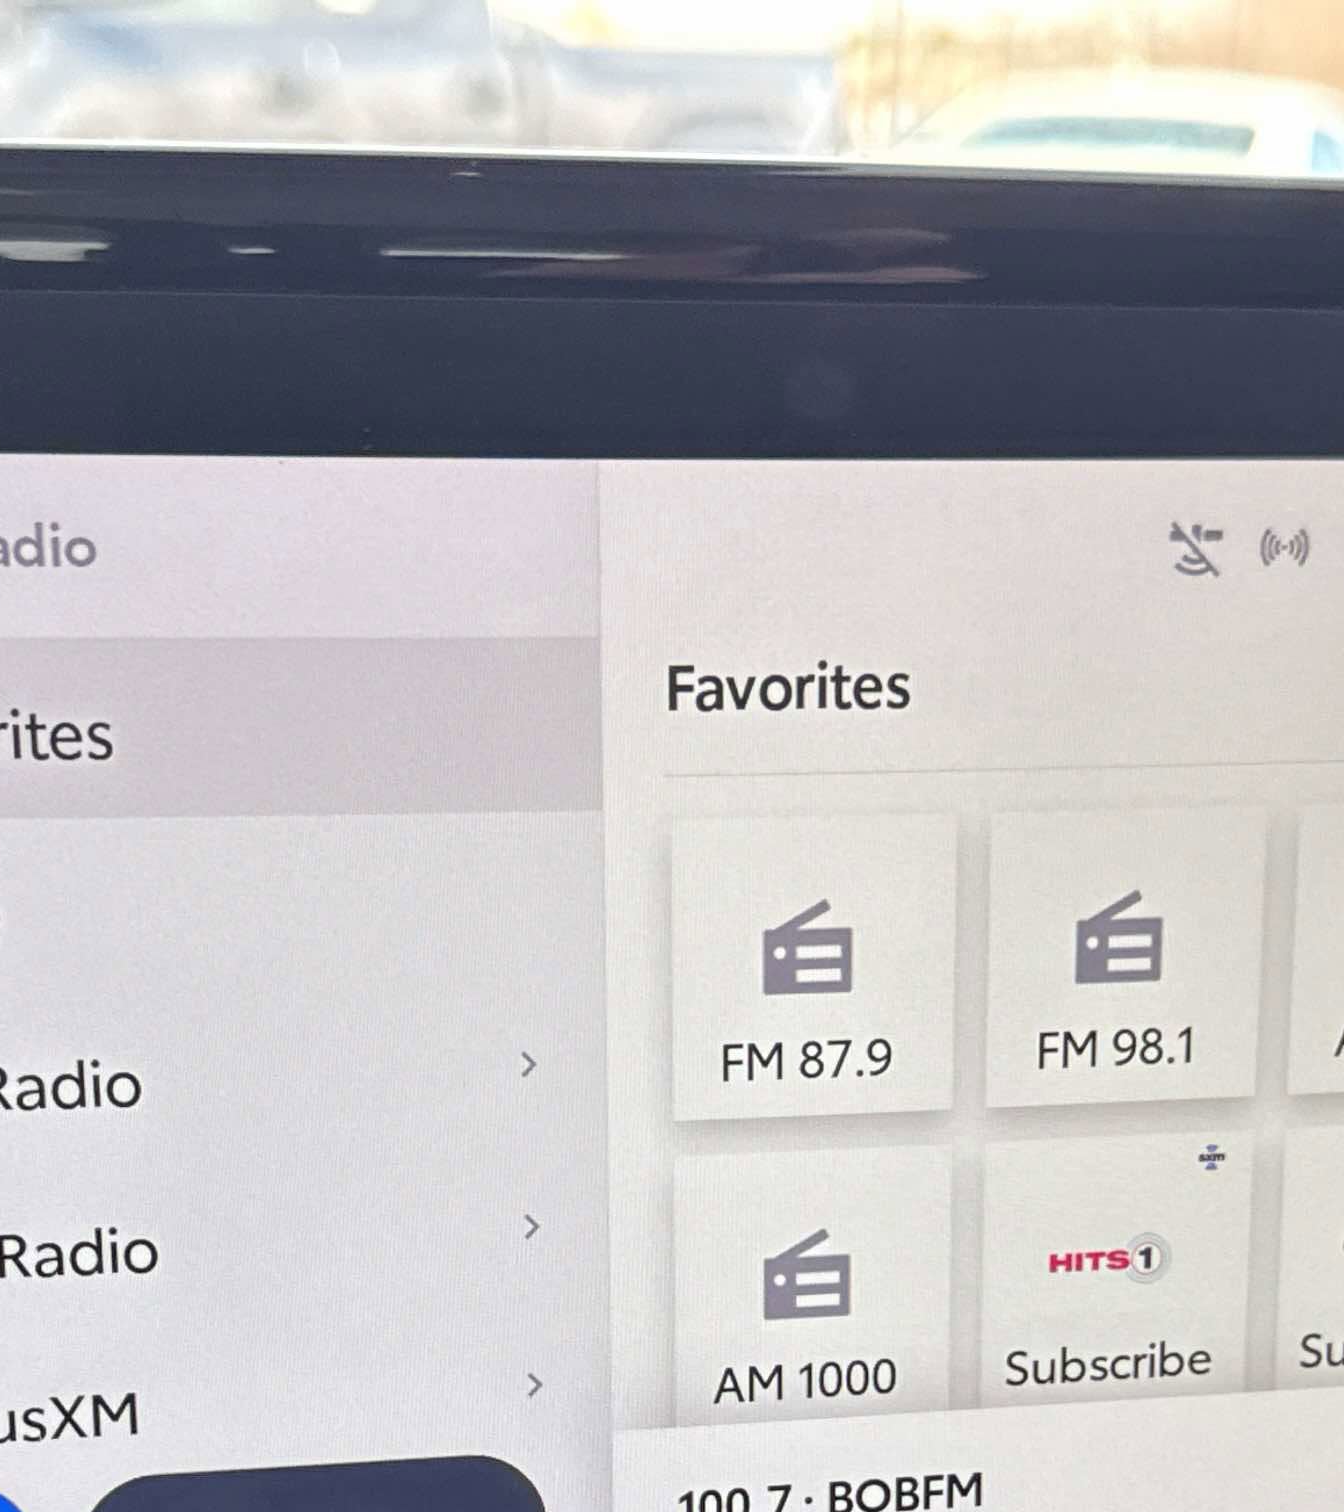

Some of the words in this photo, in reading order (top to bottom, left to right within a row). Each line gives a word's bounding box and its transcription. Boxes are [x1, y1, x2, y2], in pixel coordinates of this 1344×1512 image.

[668, 659, 911, 713] Favorites
[722, 1041, 783, 1082] FM
[799, 1037, 892, 1079] 87.9
[1038, 1030, 1097, 1070] FM
[1112, 1026, 1193, 1067] 98.1
[713, 1364, 783, 1405] AM
[799, 1358, 897, 1399] 1000
[1005, 1340, 1212, 1387] Subscribe
